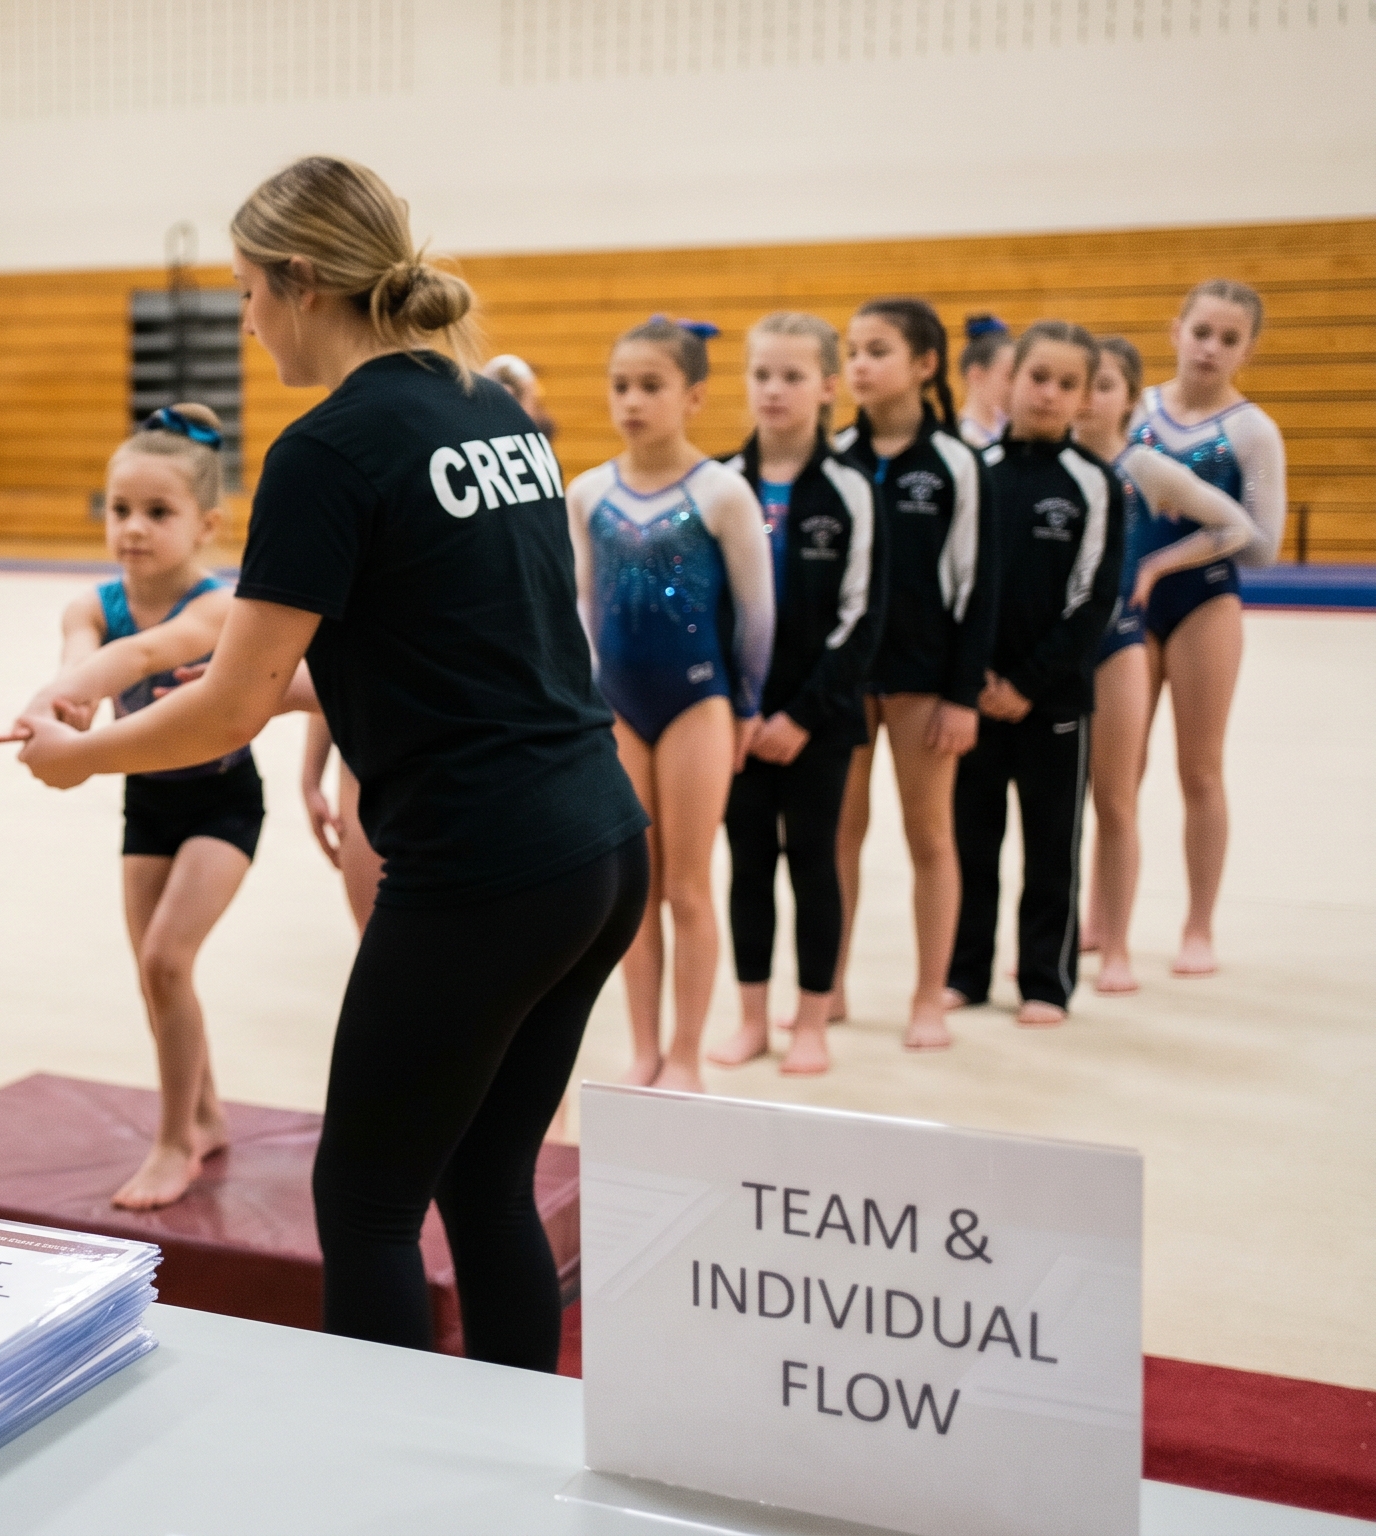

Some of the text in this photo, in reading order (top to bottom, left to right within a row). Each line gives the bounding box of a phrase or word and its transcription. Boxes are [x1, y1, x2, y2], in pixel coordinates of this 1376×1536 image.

[429, 432, 564, 518] CREW
[741, 1181, 993, 1264] TEAM &
[692, 1260, 1058, 1364] INDIVIDUAL
[782, 1359, 961, 1436] FLOW
